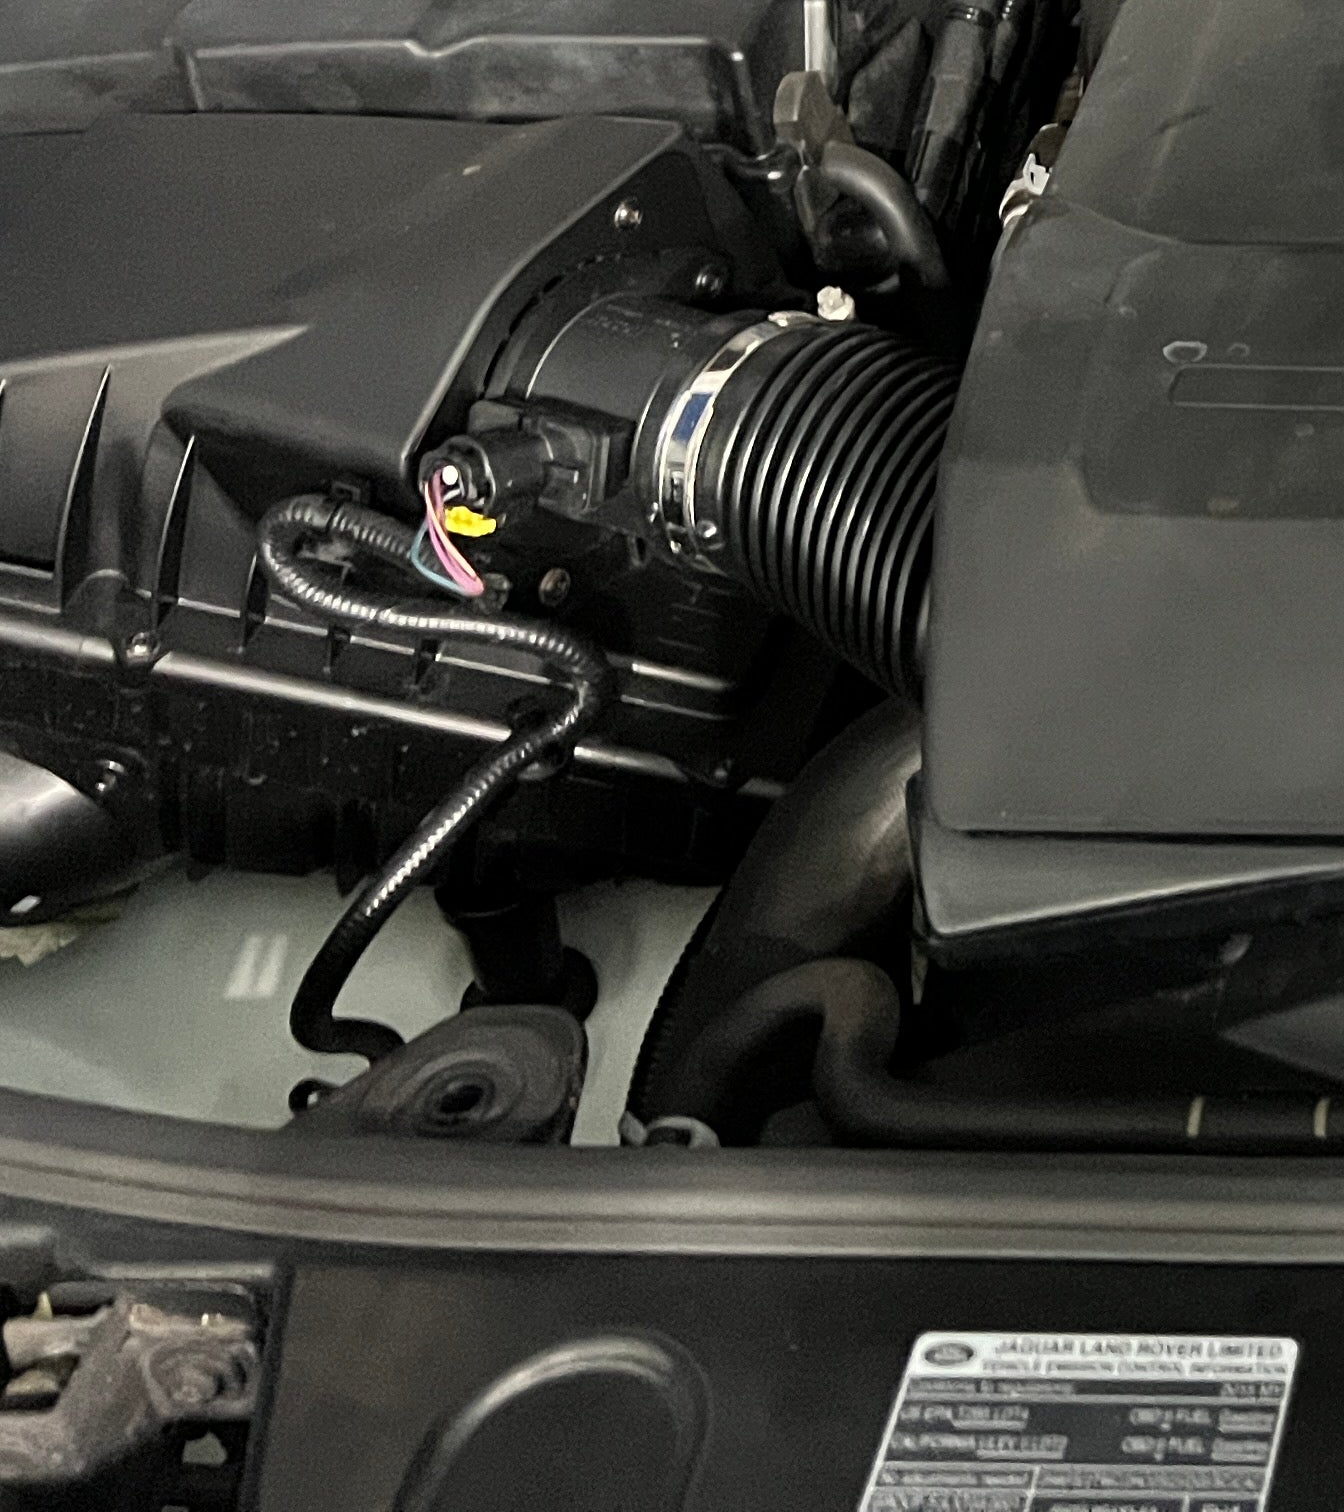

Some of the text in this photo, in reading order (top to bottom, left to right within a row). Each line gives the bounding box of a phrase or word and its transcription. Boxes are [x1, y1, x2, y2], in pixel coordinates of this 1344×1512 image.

[995, 1338, 1283, 1358] JAGUAR LAND ROVER LIMITED
